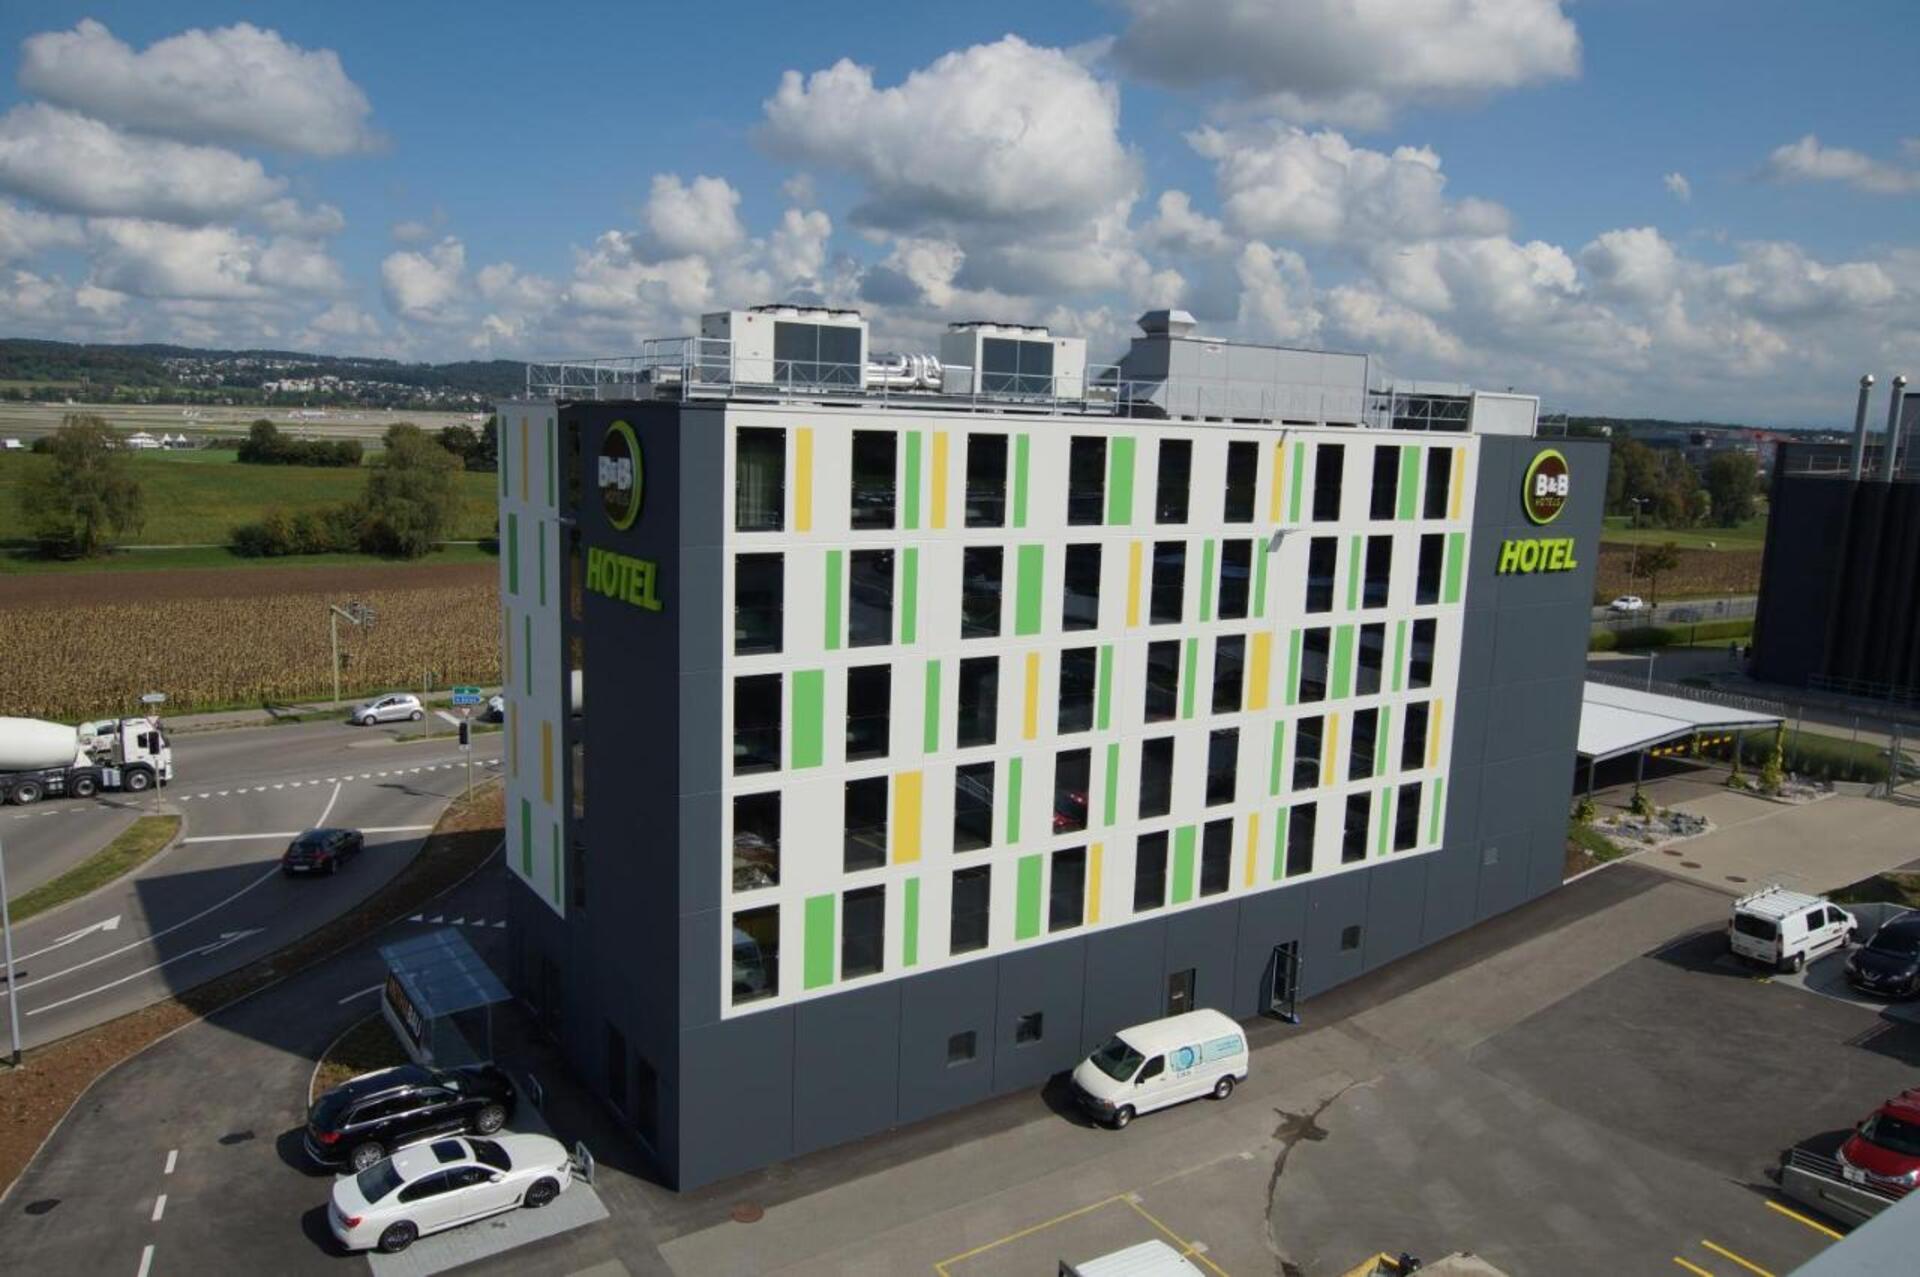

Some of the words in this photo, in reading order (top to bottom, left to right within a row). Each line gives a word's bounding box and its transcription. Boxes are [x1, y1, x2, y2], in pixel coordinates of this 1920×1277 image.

[1535, 474, 1569, 496] B&B
[1499, 538, 1578, 573] HOTEL
[586, 547, 662, 611] HOTEL
